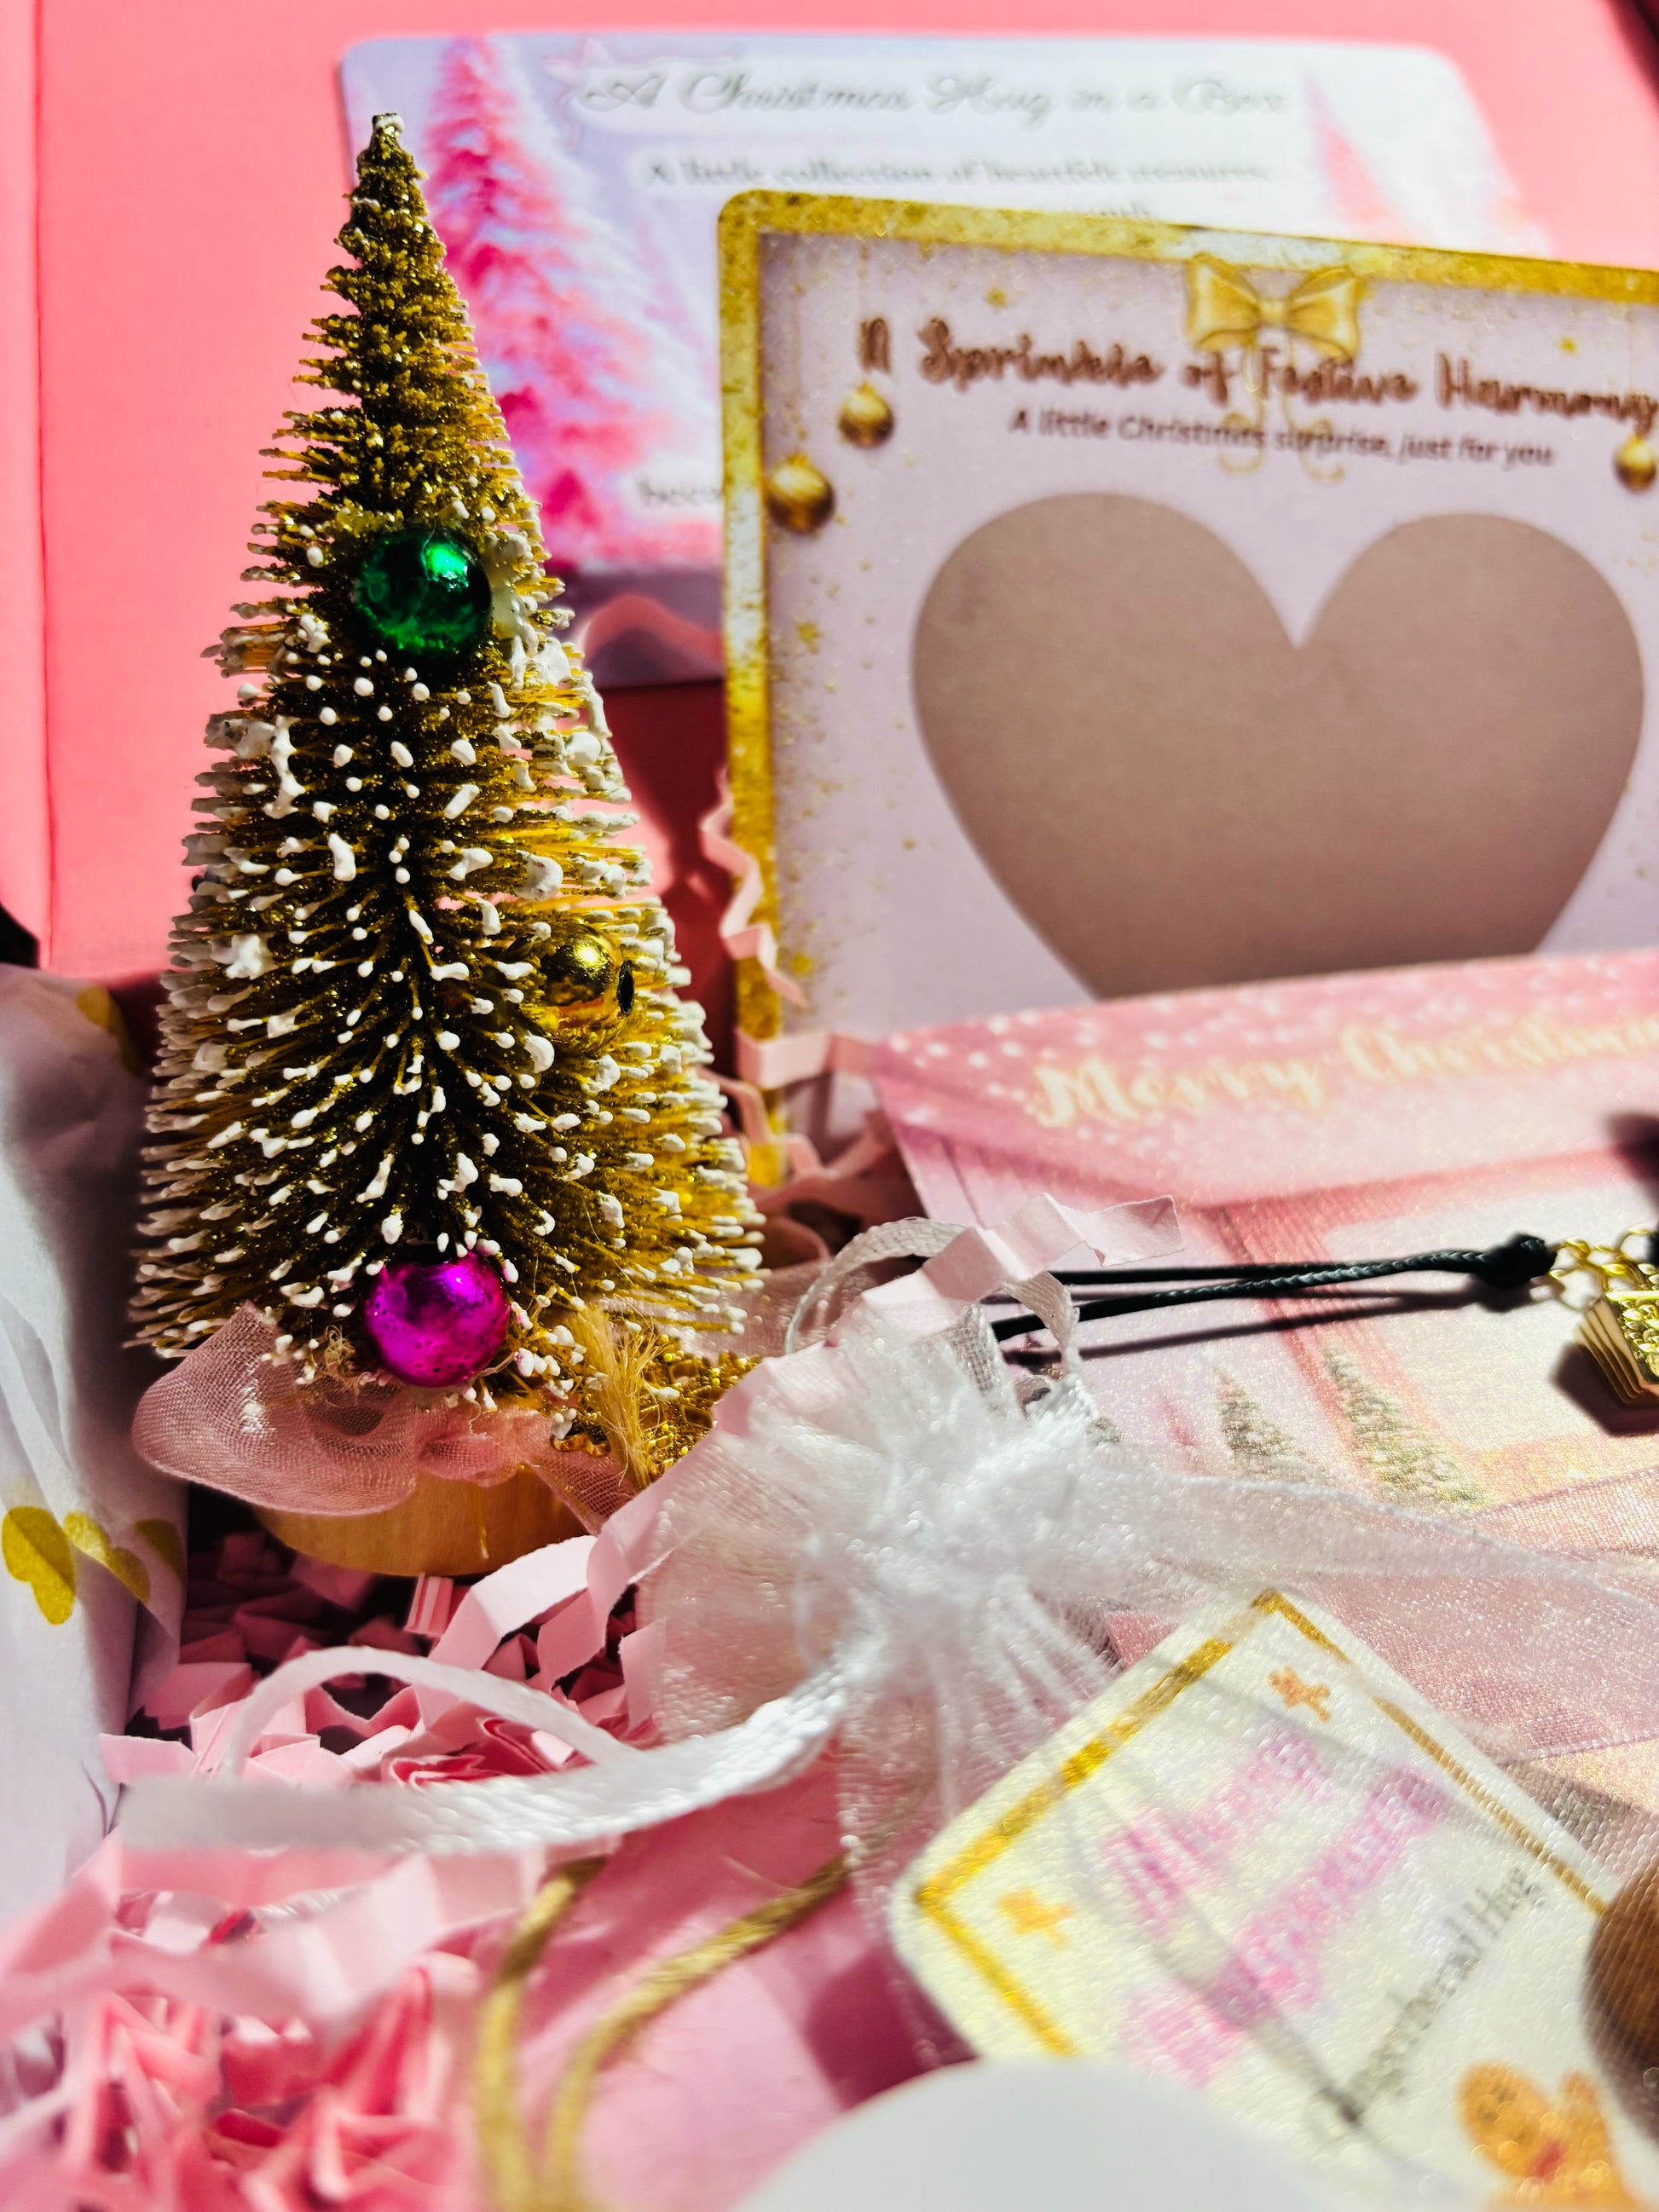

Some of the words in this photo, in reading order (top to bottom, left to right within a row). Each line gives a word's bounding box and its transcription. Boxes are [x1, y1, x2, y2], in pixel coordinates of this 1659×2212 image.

[584, 73, 668, 112] A
[682, 72, 912, 114] Christmas
[1009, 407, 1030, 434] A
[1039, 407, 1109, 440] little
[1118, 414, 1265, 449] Christmas
[1275, 425, 1390, 460] surprise,
[1398, 431, 1449, 465] just
[1459, 435, 1498, 463] for
[1504, 444, 1555, 471] you
[1030, 1057, 1323, 1129] Merry
